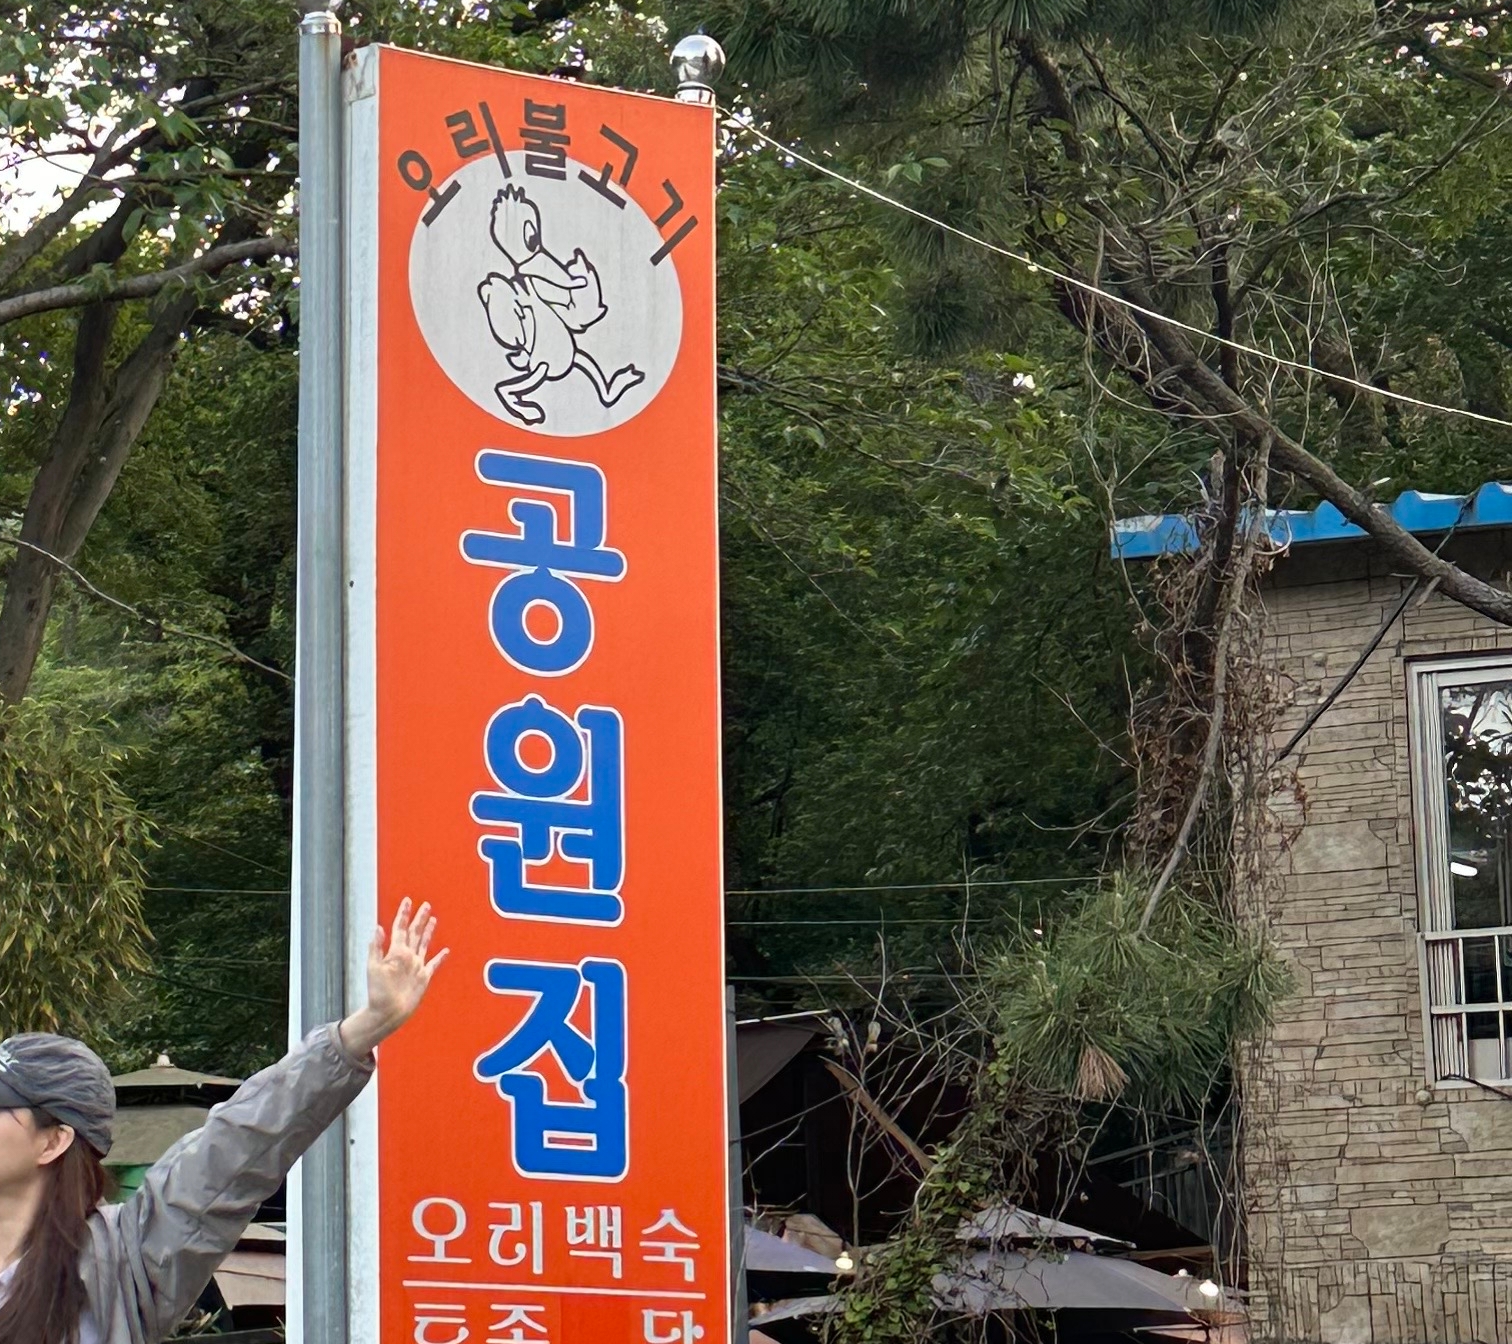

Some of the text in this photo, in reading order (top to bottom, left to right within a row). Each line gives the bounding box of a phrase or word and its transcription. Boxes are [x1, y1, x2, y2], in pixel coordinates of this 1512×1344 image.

[397, 99, 698, 266] 오리불고기
[459, 448, 630, 1183] 공원집
[405, 1195, 700, 1282] 오리백숙
